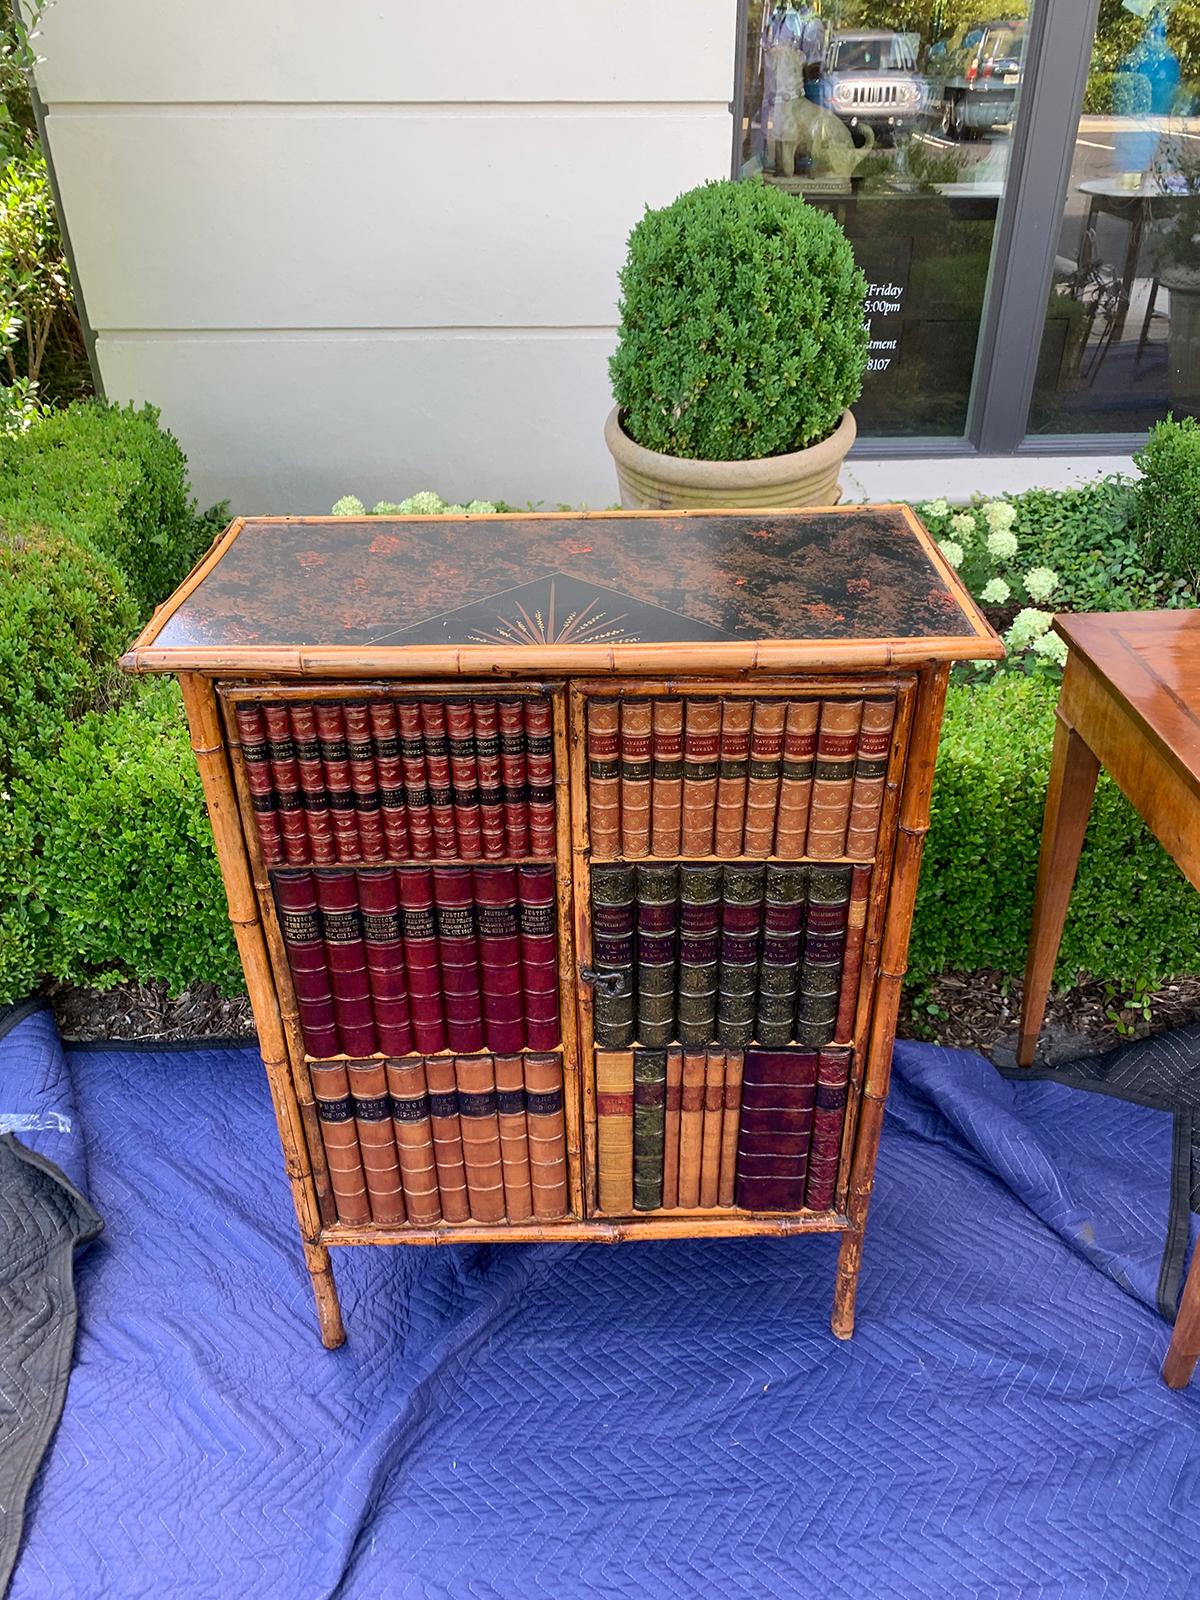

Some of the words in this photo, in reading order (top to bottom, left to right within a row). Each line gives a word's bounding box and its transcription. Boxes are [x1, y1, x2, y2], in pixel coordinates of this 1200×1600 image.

[868, 283, 904, 299] Friday
[864, 300, 900, 315] 5:00pm
[866, 359, 891, 370] 8107
